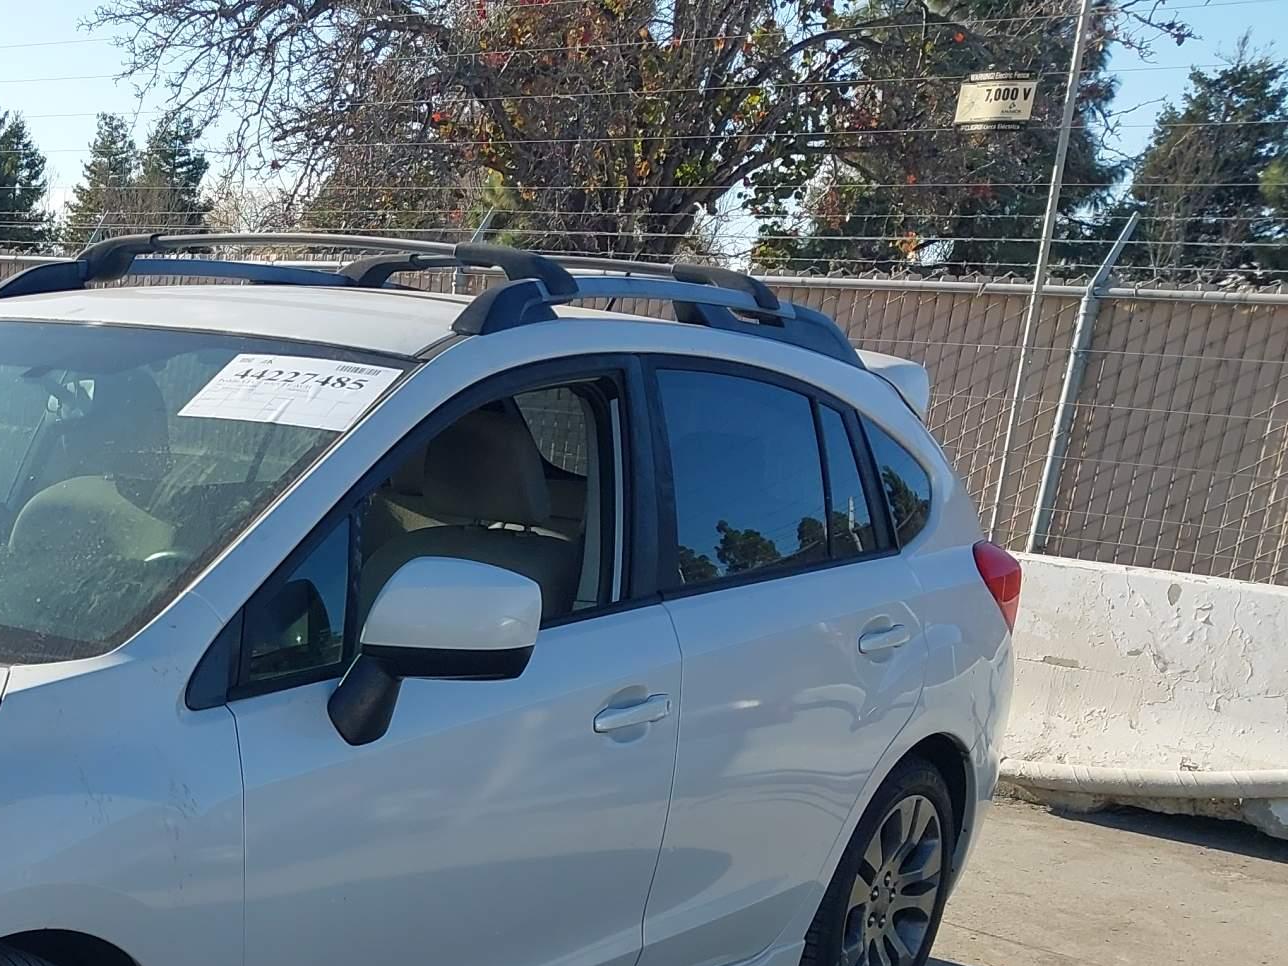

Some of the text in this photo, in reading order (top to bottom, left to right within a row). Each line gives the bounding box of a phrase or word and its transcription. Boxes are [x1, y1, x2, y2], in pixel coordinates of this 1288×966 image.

[984, 87, 1032, 103] 7,000 V
[234, 368, 369, 391] 44227485
